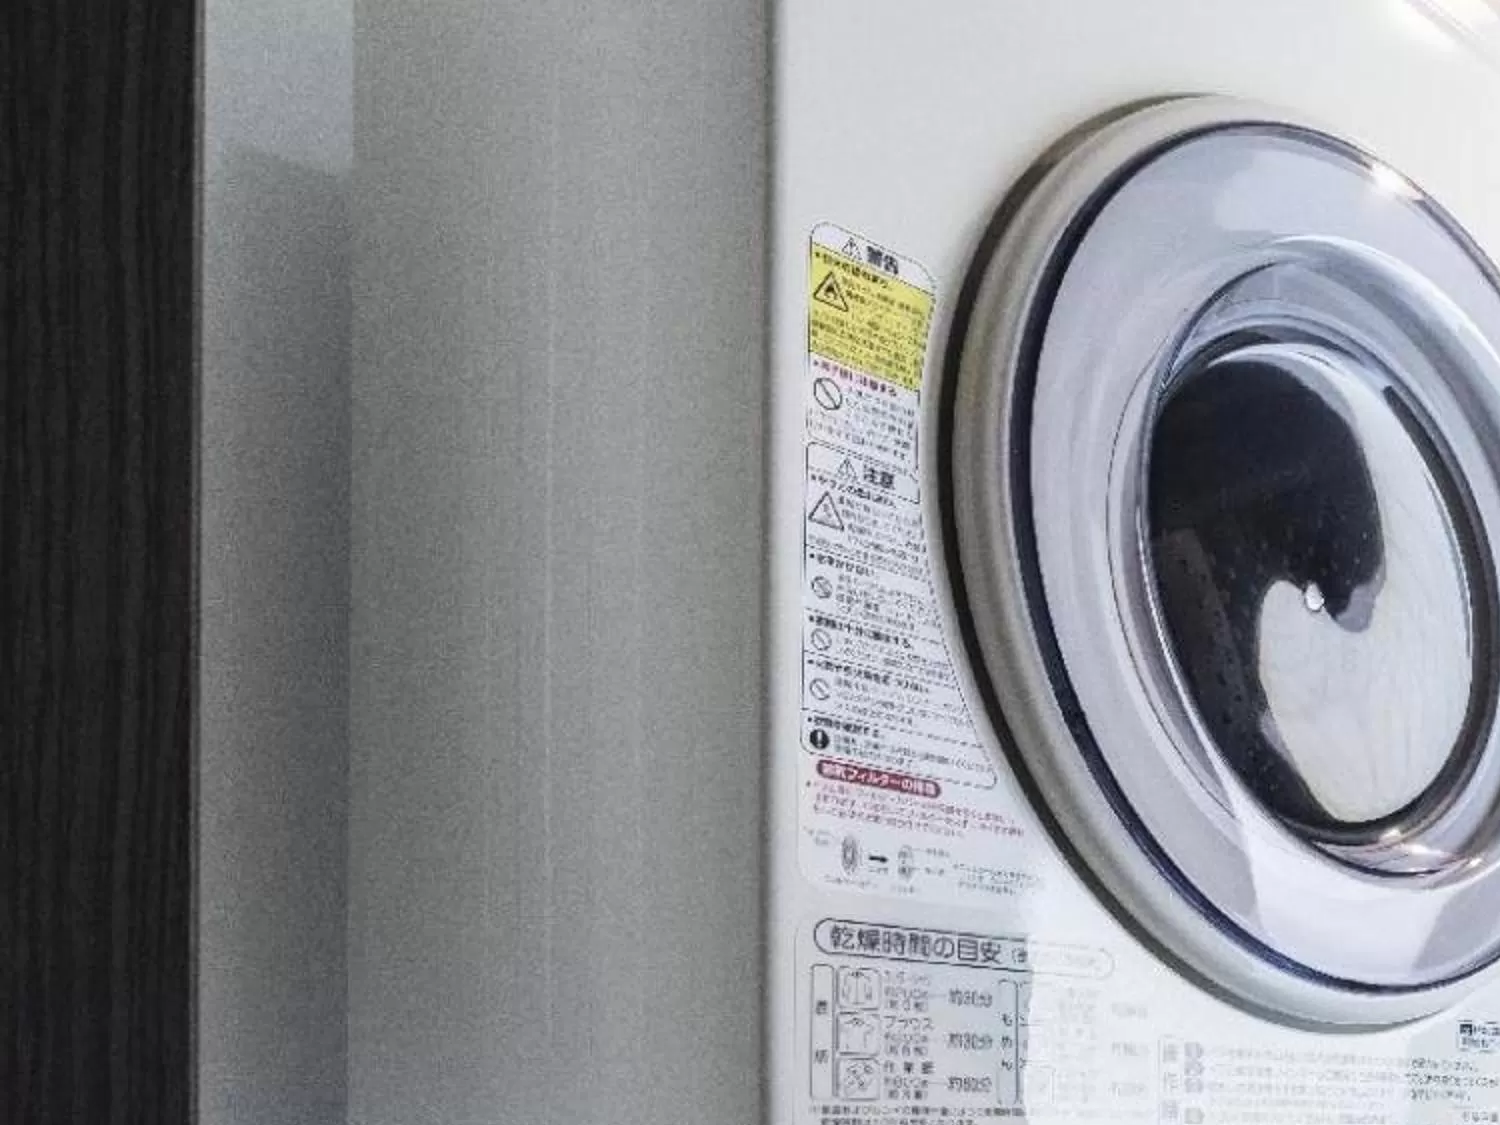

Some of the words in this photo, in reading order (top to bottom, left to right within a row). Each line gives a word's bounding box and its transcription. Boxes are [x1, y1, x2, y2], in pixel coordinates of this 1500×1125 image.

[829, 924, 1002, 964] 乾燥時間の目安
